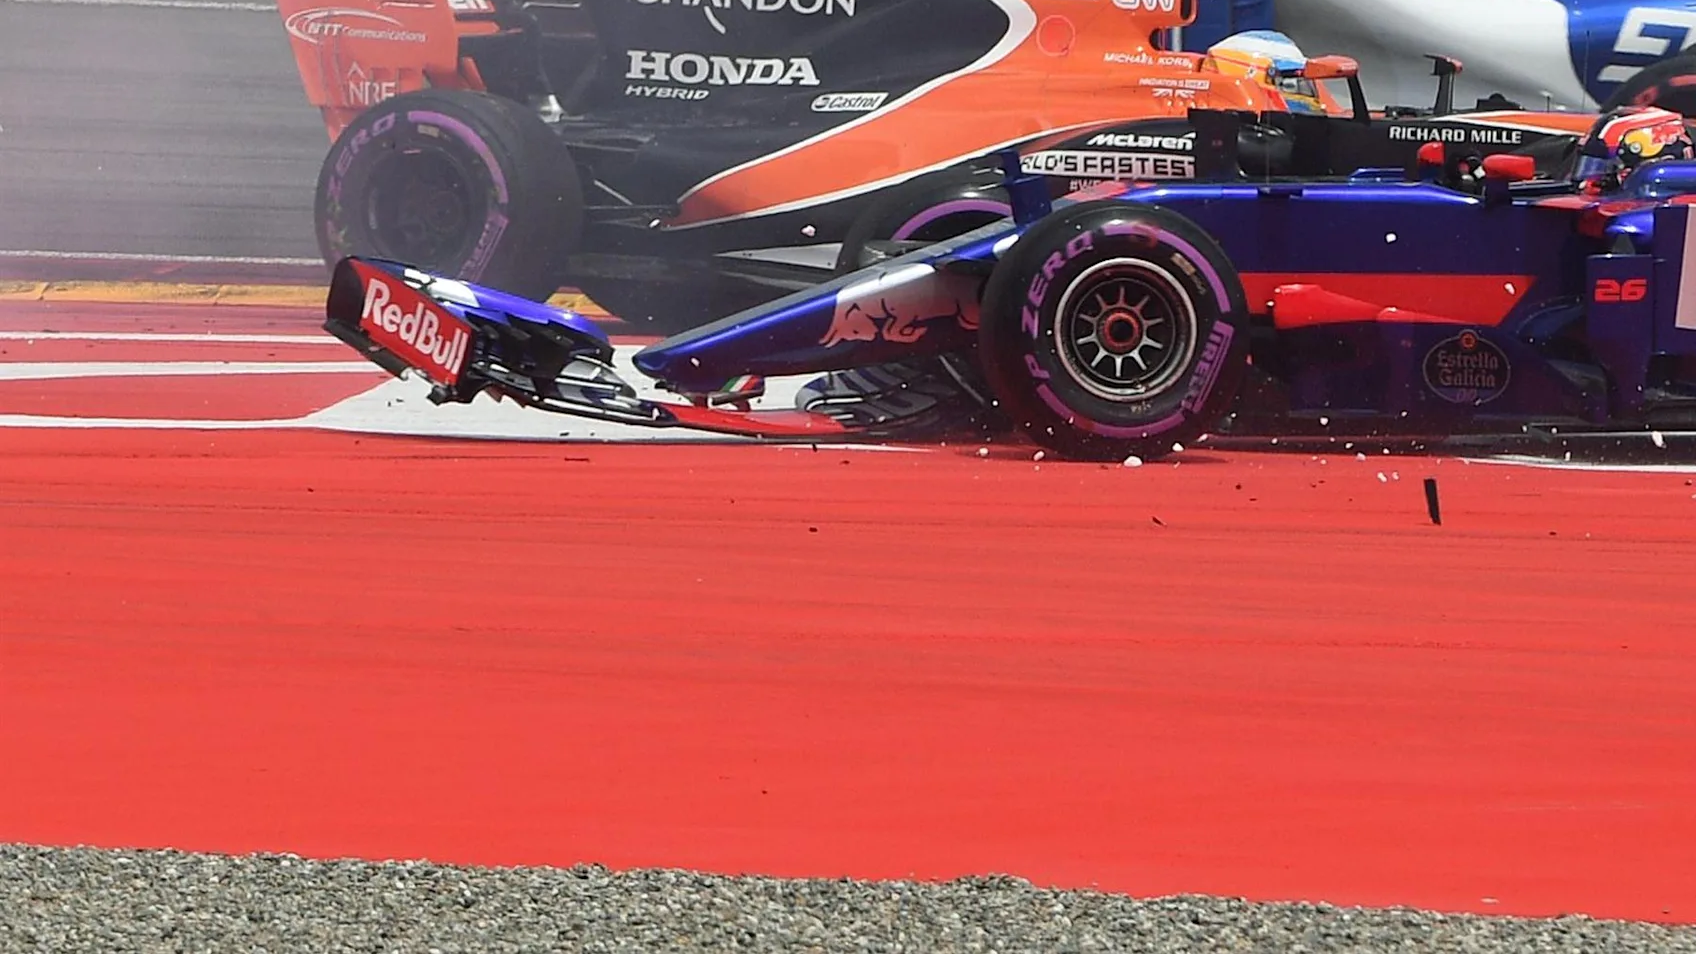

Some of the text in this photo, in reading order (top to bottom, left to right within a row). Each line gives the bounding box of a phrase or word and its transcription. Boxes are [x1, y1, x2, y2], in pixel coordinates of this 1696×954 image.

[624, 49, 821, 86] HONDA
[624, 84, 710, 101] HYBRID
[828, 93, 880, 110] Castrol
[1086, 132, 1197, 151] McLaren
[1389, 125, 1522, 144] RICHARD MILLE
[1021, 230, 1094, 339] ZERO
[1594, 278, 1648, 302] 26
[1437, 350, 1499, 370] Estrella
[1440, 368, 1496, 388] Galicia
